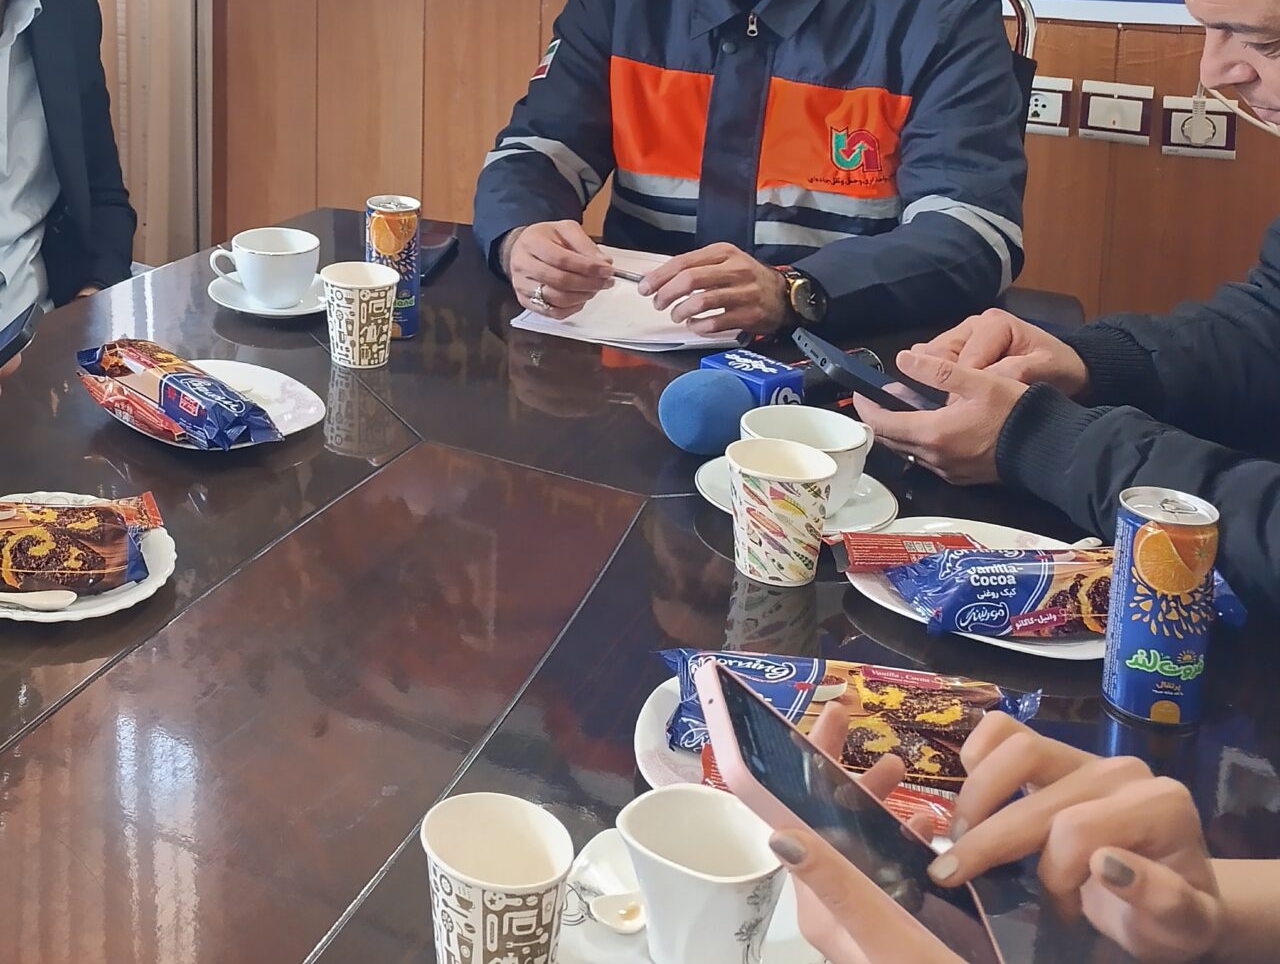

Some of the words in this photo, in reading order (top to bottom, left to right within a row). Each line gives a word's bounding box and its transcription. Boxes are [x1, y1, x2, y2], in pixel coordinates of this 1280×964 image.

[970, 574, 1017, 587] Cocoa
[976, 589, 1000, 600] روغنی
[1000, 588, 1017, 598] کیک
